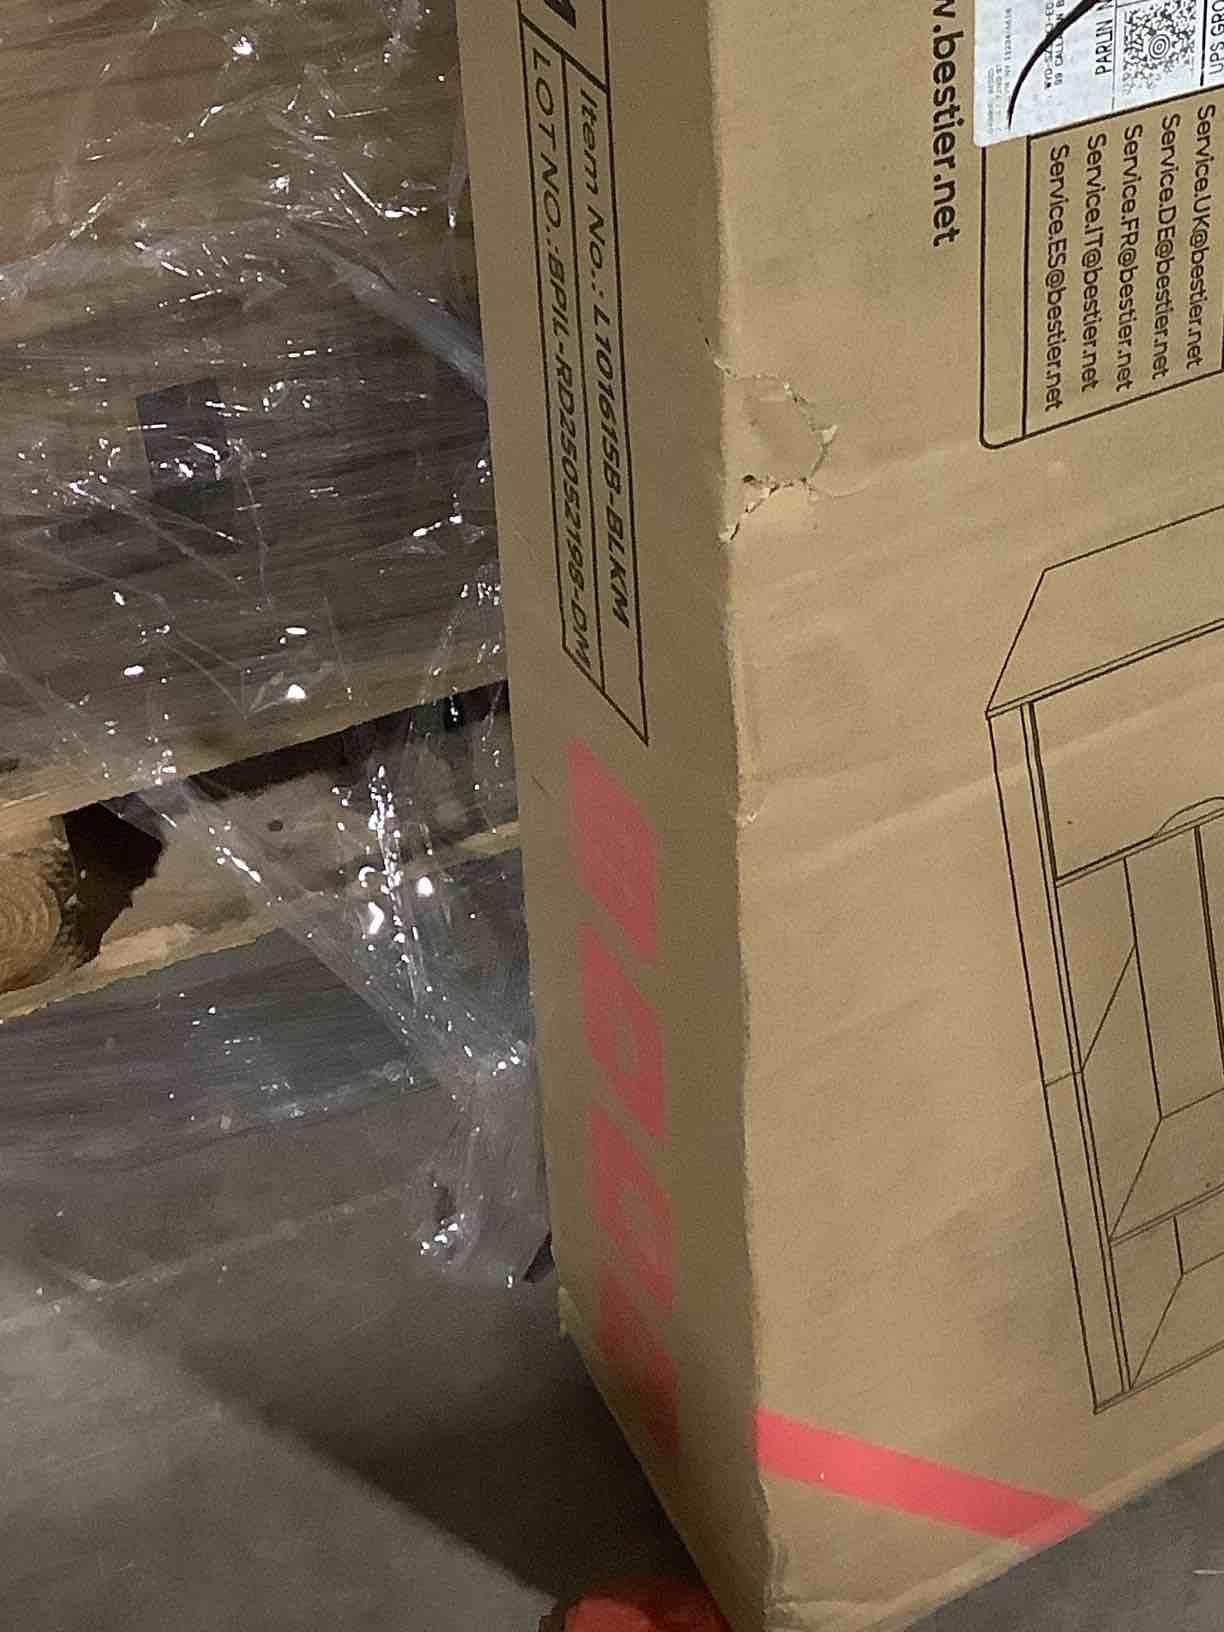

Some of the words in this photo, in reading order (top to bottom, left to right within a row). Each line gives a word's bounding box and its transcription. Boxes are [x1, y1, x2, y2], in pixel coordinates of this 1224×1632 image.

[531, 46, 558, 152] LOT
[578, 88, 600, 208] Item
[1094, 16, 1114, 78] PARLIN
[1045, 143, 1070, 413] Service.ES@bestier.net
[1080, 133, 1107, 393] Service.IT@bestier.net
[1115, 124, 1144, 392] Service.FR@bestier.net
[1151, 113, 1181, 381] Service.DE@bestier.net
[1186, 103, 1216, 370] Service.UK@bestier.net
